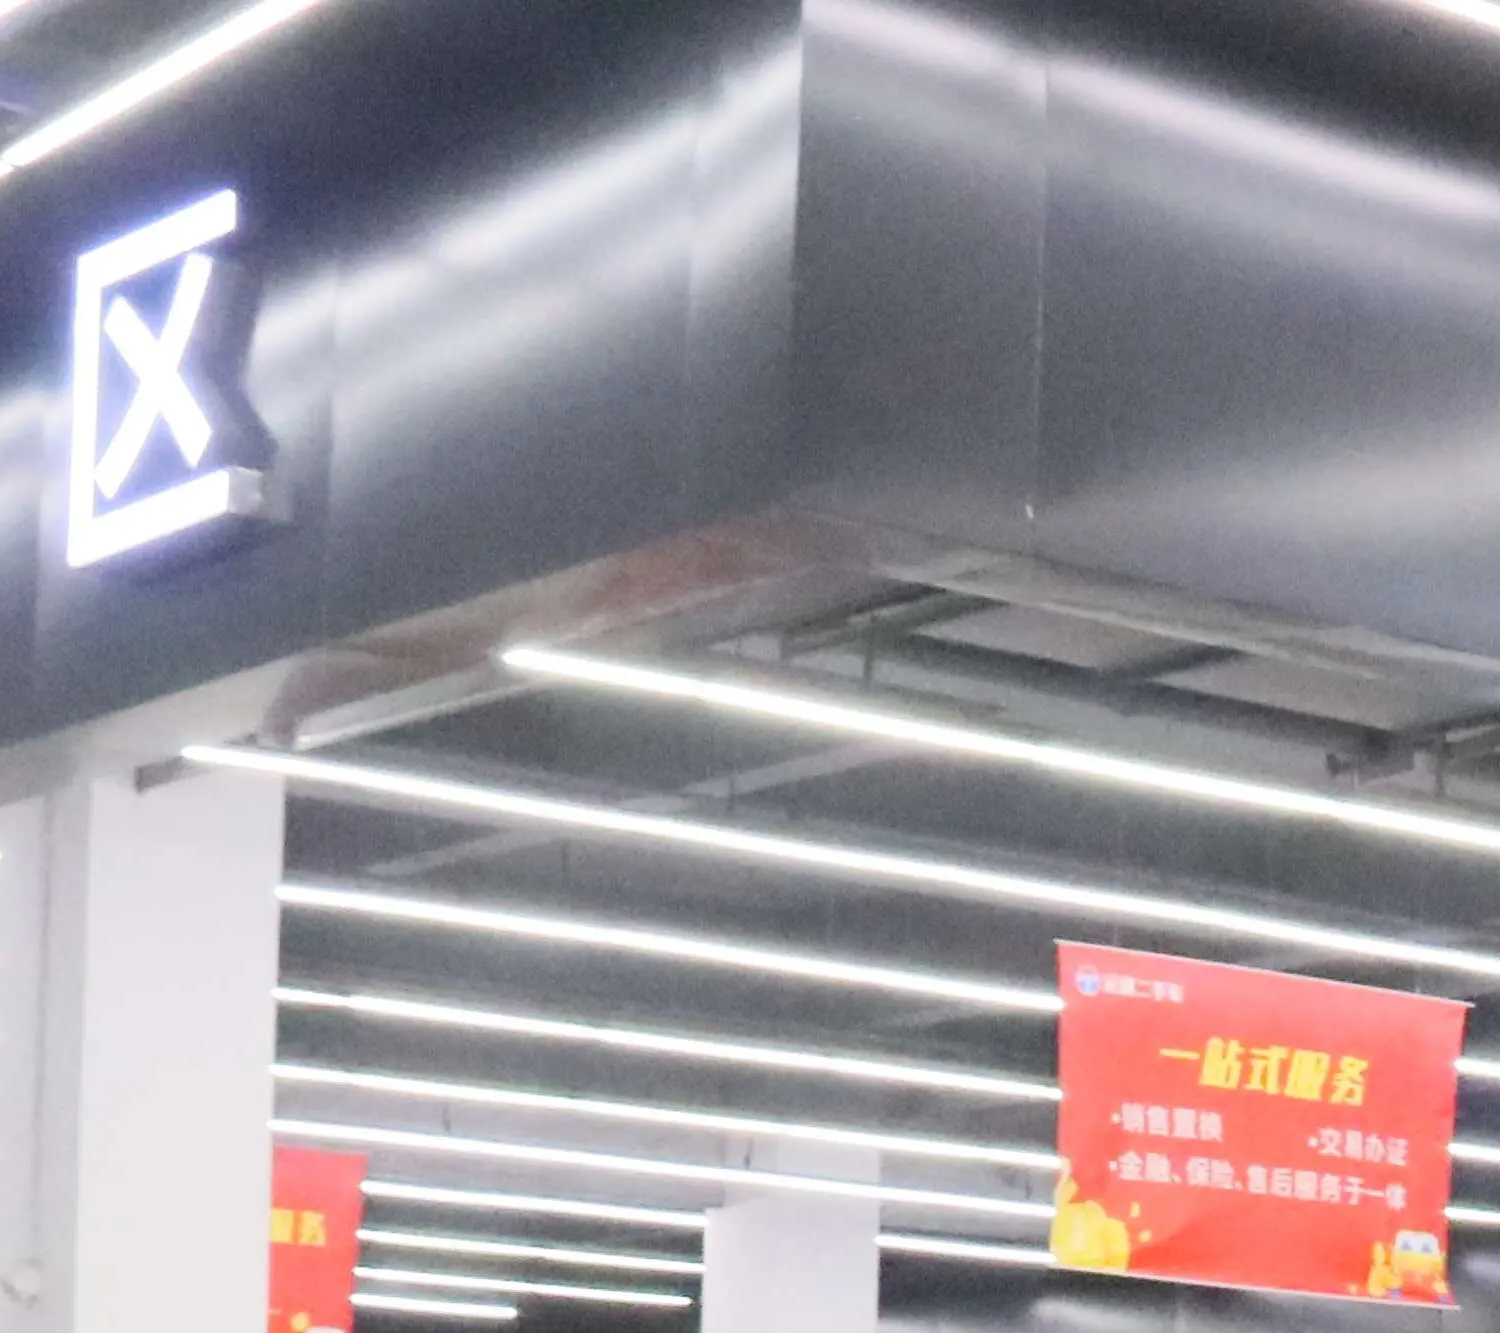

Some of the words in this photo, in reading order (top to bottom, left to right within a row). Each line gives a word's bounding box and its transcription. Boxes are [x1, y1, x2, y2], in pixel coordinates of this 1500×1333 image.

[1159, 1036, 1370, 1107] 一站式服务
